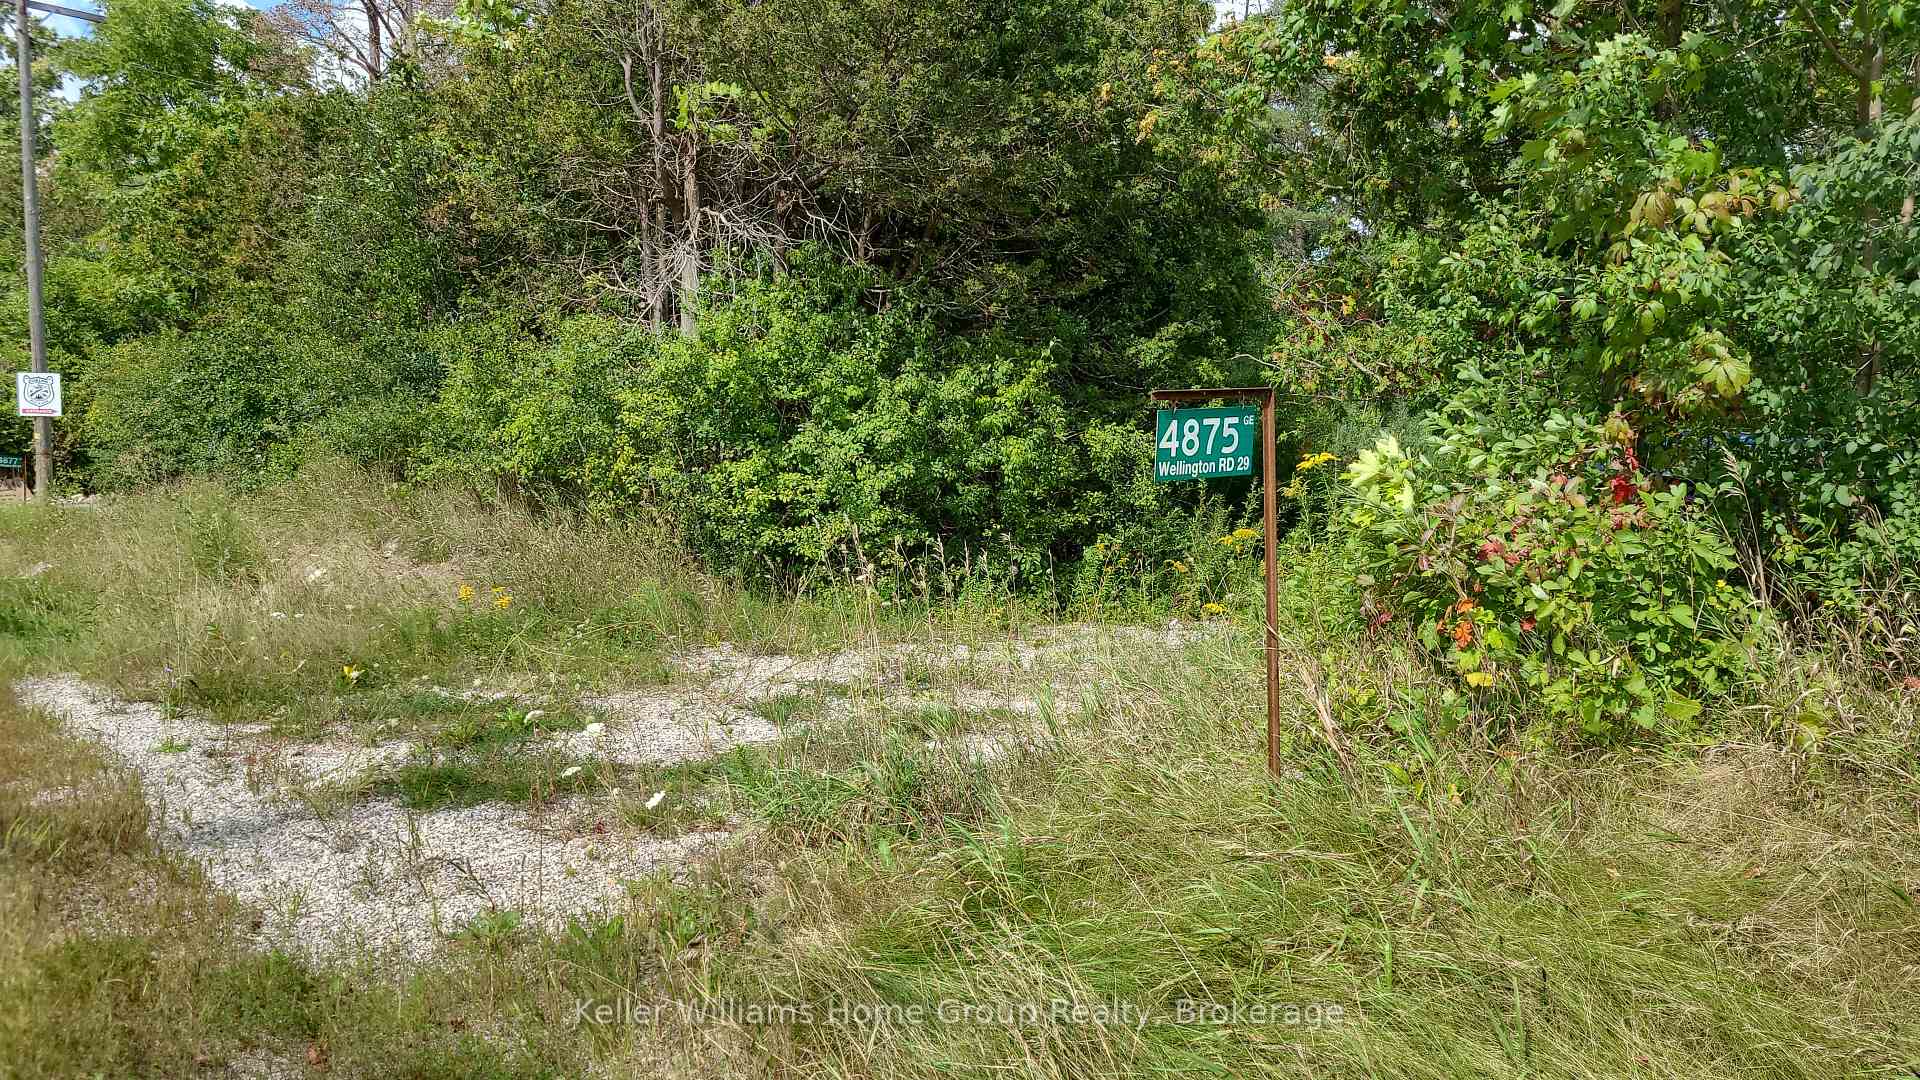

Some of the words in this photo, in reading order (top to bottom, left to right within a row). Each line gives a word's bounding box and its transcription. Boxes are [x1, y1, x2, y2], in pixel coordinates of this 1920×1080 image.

[1159, 416, 1239, 457] 4875
[1243, 415, 1254, 425] GE
[1158, 461, 1216, 478] Wellington
[1218, 457, 1235, 473] RD
[1237, 456, 1250, 471] 29
